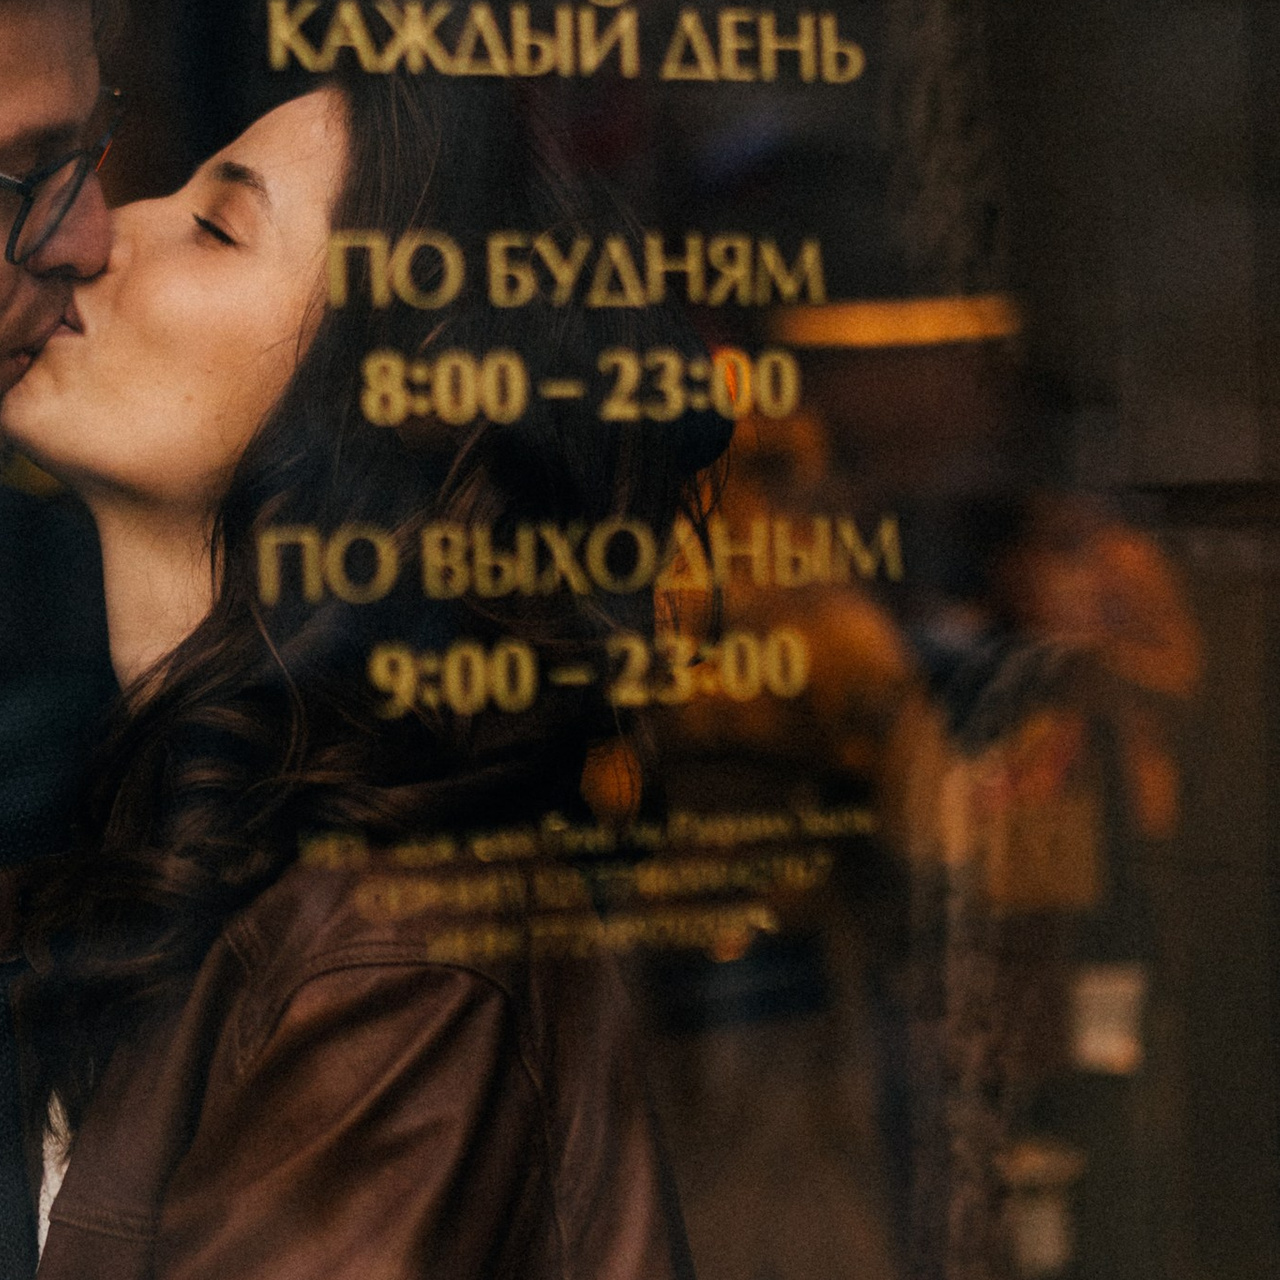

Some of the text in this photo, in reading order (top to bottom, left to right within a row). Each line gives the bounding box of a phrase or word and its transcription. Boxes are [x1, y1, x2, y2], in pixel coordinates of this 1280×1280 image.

[660, 7, 866, 84] ДЕНЬ
[327, 230, 827, 310] ПО БУДНЯМ
[360, 347, 529, 426] 8:00
[598, 347, 802, 422] 23:00
[256, 514, 904, 605] ПО ВЫХОДНЫМ
[367, 639, 539, 719] 9:00
[602, 628, 812, 707] 23:00
